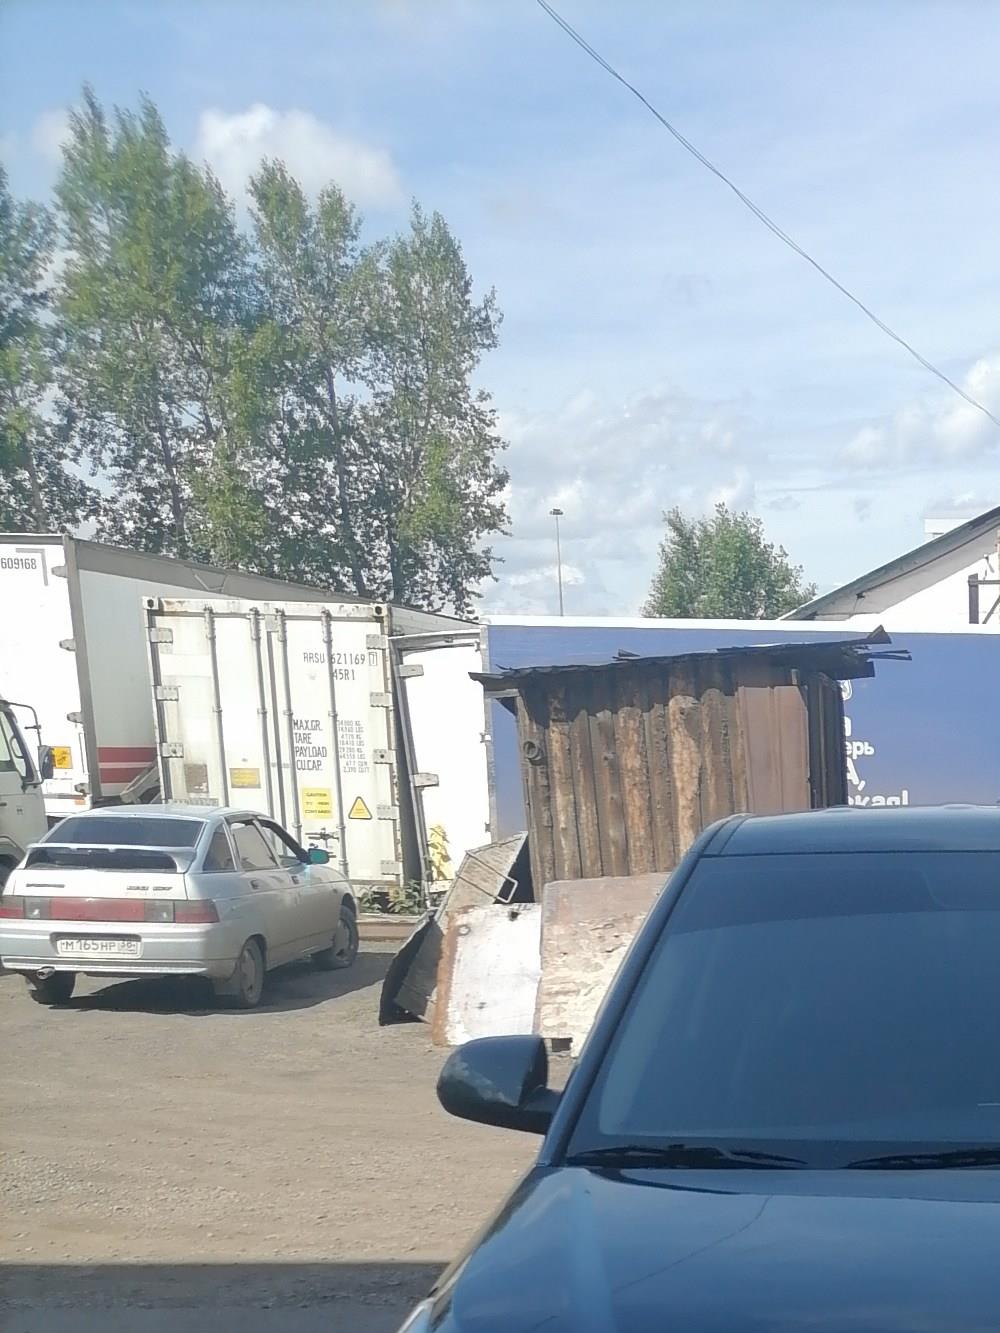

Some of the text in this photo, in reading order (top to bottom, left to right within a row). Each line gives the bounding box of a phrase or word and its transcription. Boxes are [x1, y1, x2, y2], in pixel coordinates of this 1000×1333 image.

[0, 557, 37, 570] 609168
[294, 732, 312, 744] TARE
[295, 746, 328, 758] PAYLOAD
